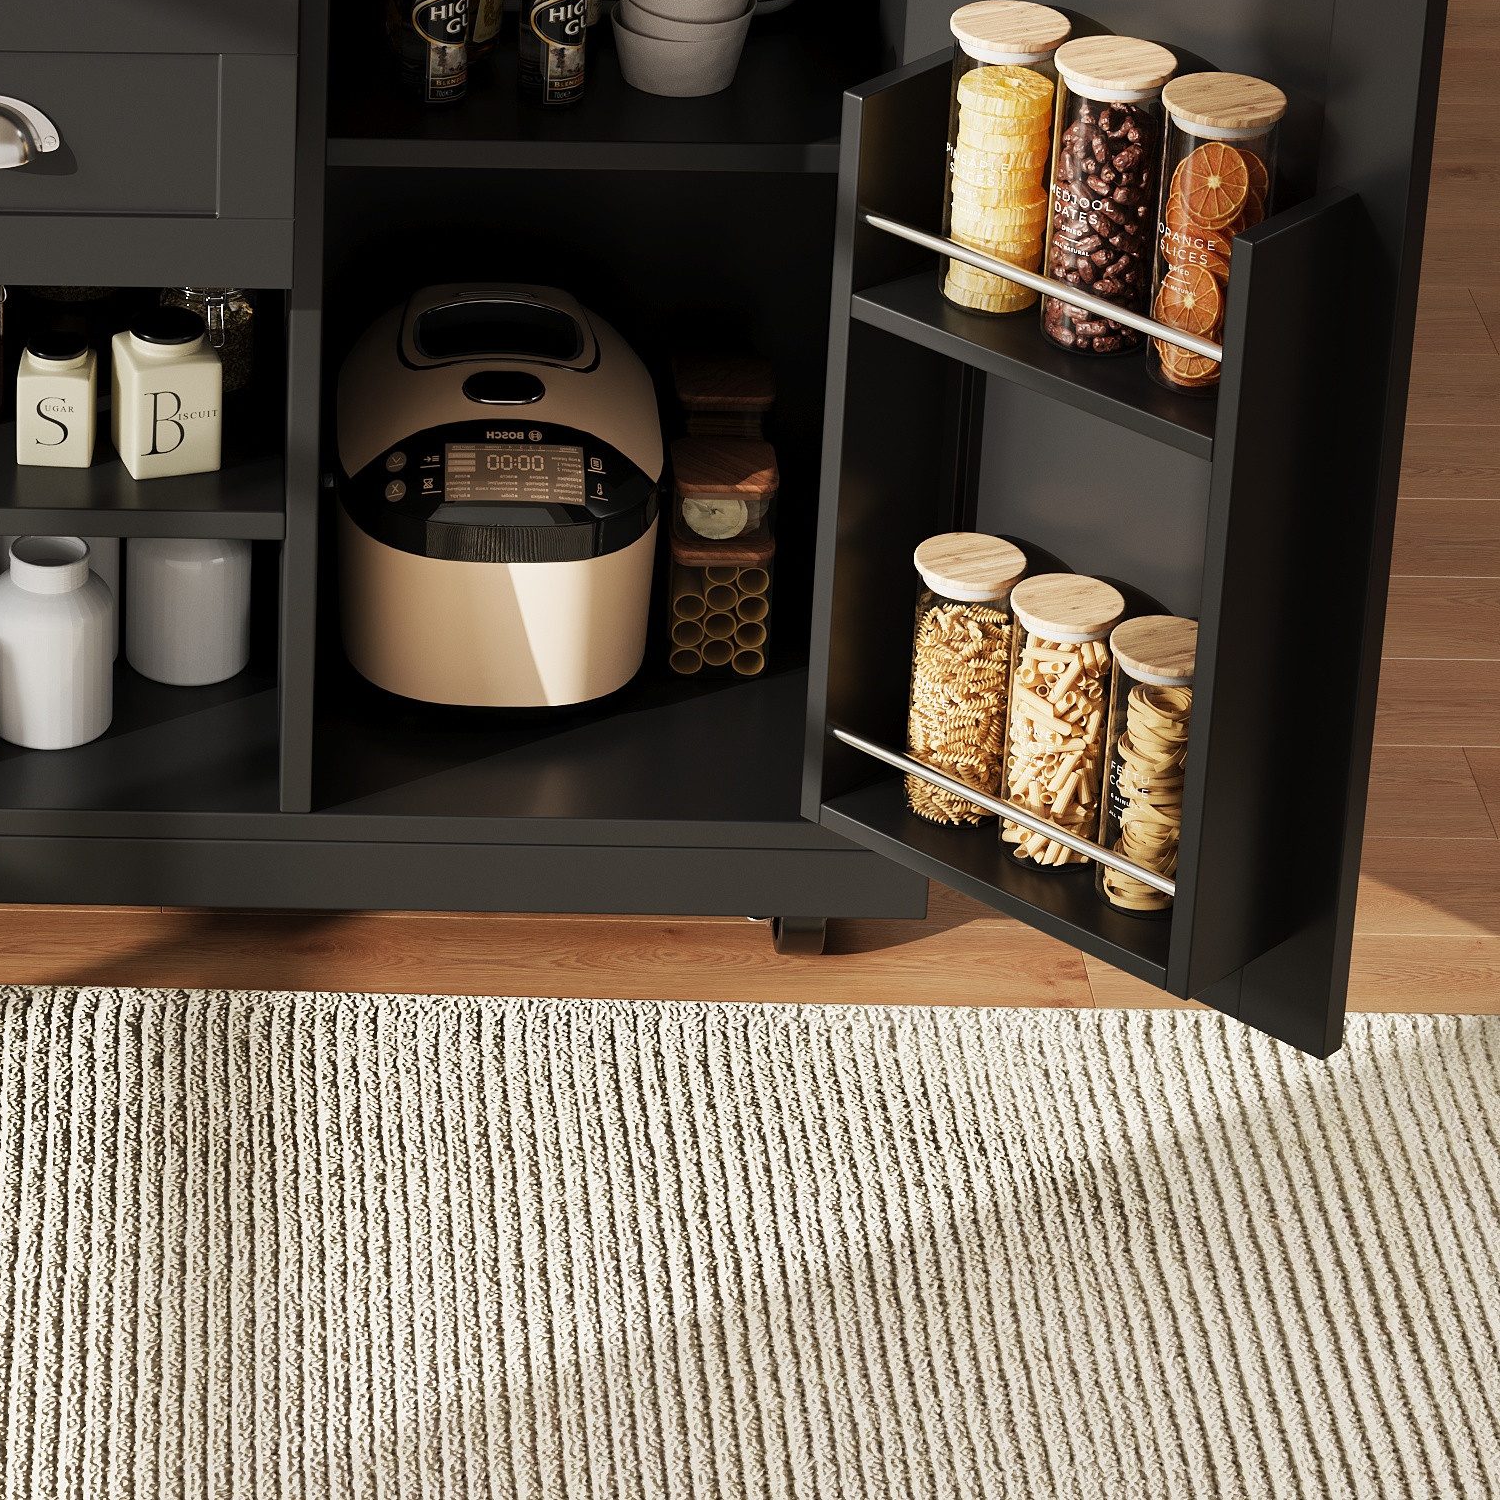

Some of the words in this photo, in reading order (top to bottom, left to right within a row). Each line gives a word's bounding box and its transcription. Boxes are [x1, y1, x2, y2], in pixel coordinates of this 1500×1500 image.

[1051, 183, 1114, 212] MEDJOOL
[1054, 200, 1098, 225] DATES
[1061, 225, 1083, 237] DRIED
[1159, 222, 1216, 251] ORANGE
[1160, 239, 1208, 265] SLICES
[1168, 263, 1190, 277] DRIED
[35, 396, 75, 446] SUGAR
[140, 391, 219, 457] BISCUIT
[1110, 760, 1150, 787] FETTU
